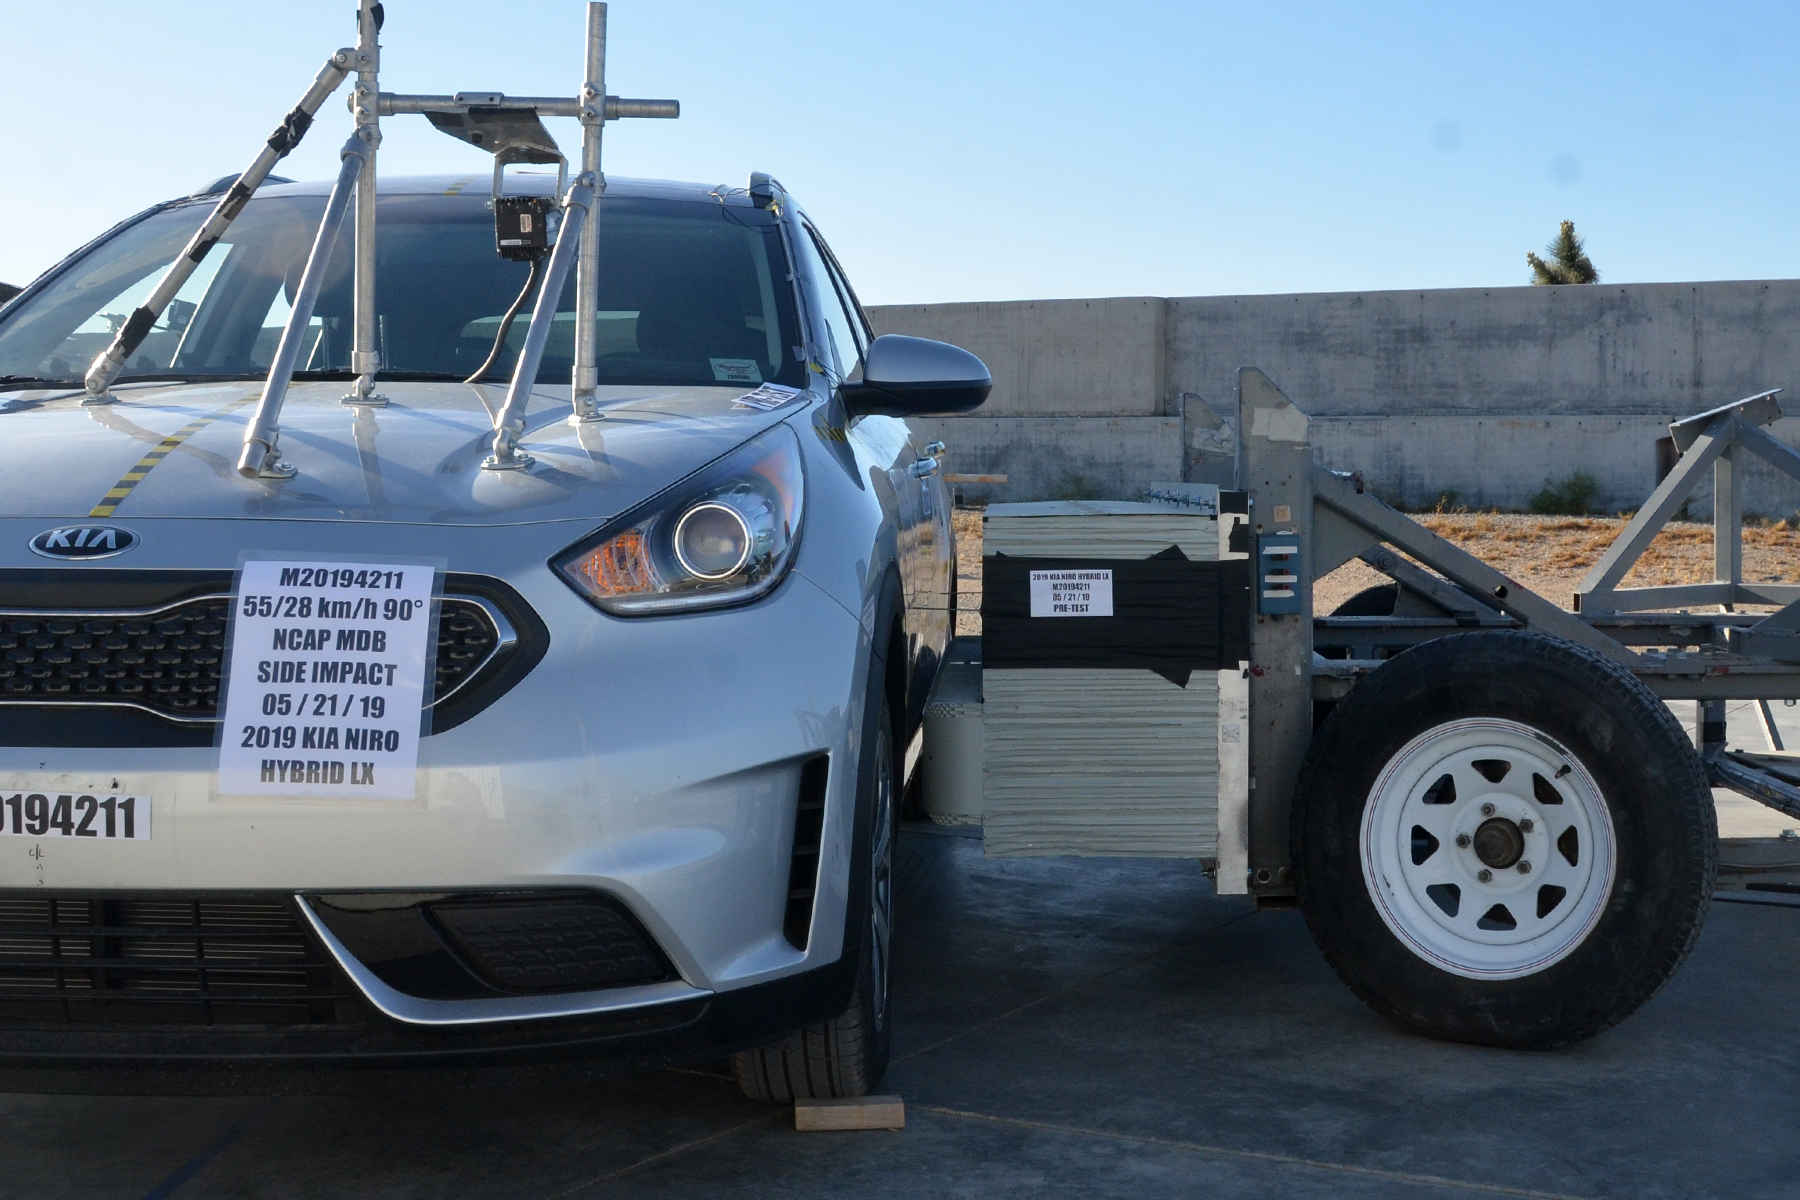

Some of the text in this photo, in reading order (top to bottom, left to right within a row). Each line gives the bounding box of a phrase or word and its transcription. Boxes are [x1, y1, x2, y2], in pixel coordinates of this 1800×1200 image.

[45, 529, 116, 549] KIA
[279, 568, 404, 589] M20194211
[1032, 573, 1049, 581] 2019
[1102, 572, 1110, 580] LX
[1052, 583, 1090, 591] M20194211
[243, 596, 423, 621] 55/28 km/h 90°
[1052, 593, 1062, 601] 05
[1068, 593, 1076, 601] 21
[1082, 593, 1090, 601] 19
[1053, 604, 1089, 612] PRE-TEST
[272, 628, 387, 652] NCAP MDB
[257, 661, 397, 686] SIDE IMPACT
[262, 693, 292, 716] 05
[312, 693, 338, 717] 21
[360, 696, 386, 719] 19
[241, 726, 399, 752] 2019 KIA NIRO
[260, 759, 375, 785] HYBRID LX
[0, 793, 136, 839] 194211
